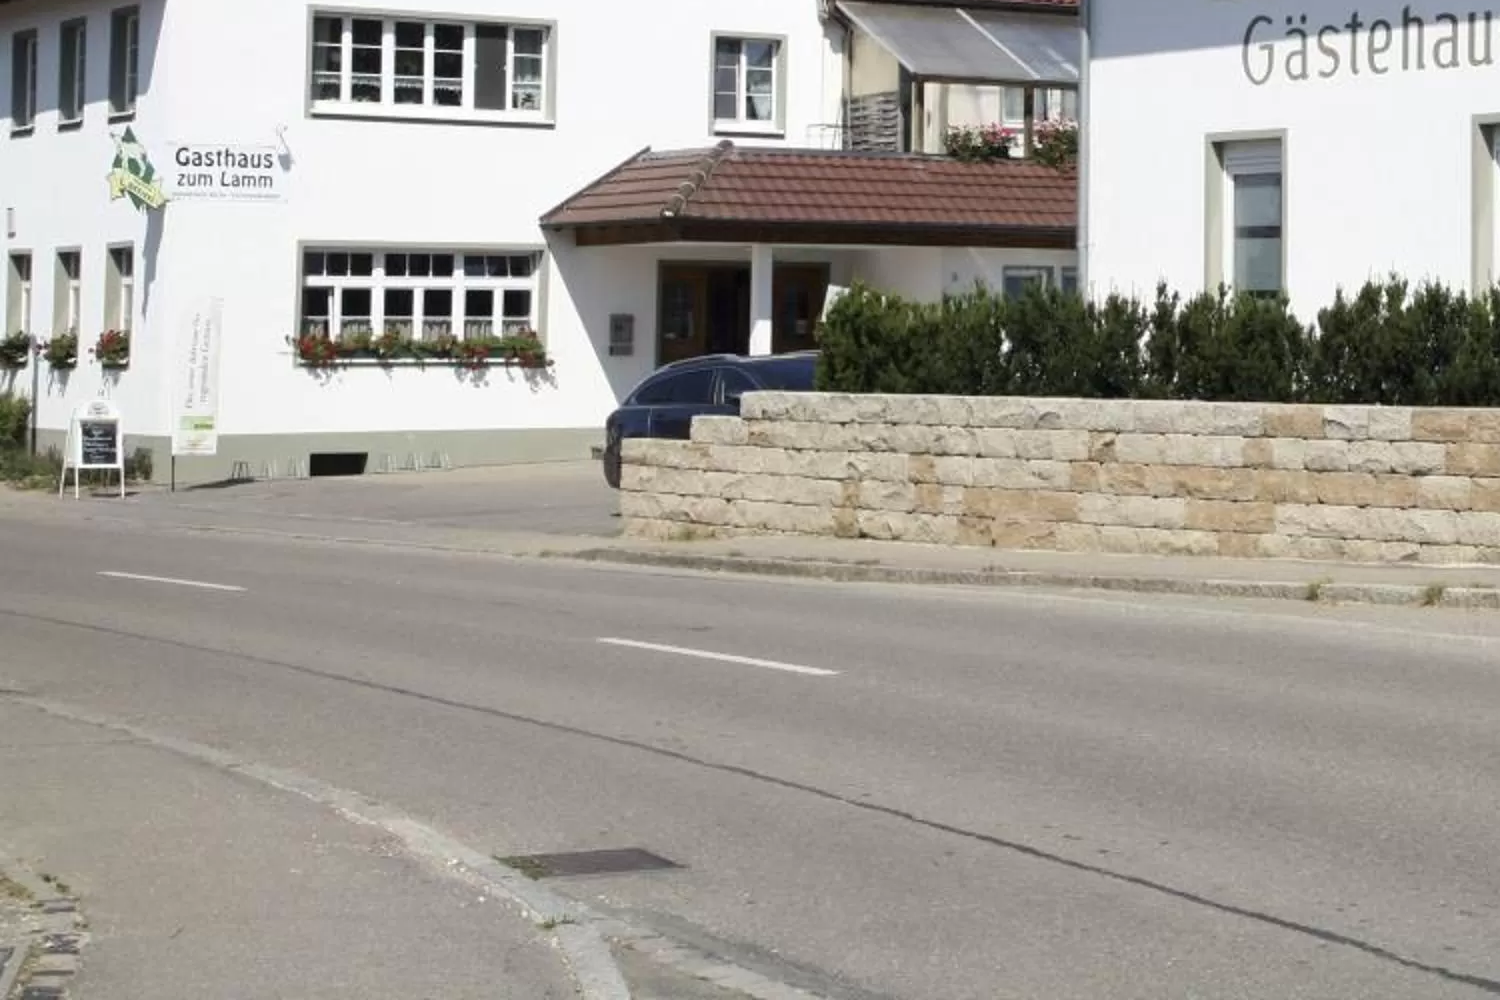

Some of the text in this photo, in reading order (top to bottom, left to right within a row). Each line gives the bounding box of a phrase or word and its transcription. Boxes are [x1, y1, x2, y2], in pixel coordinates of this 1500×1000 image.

[175, 147, 274, 169] Gasthaus
[177, 172, 273, 188] zum Lamm
